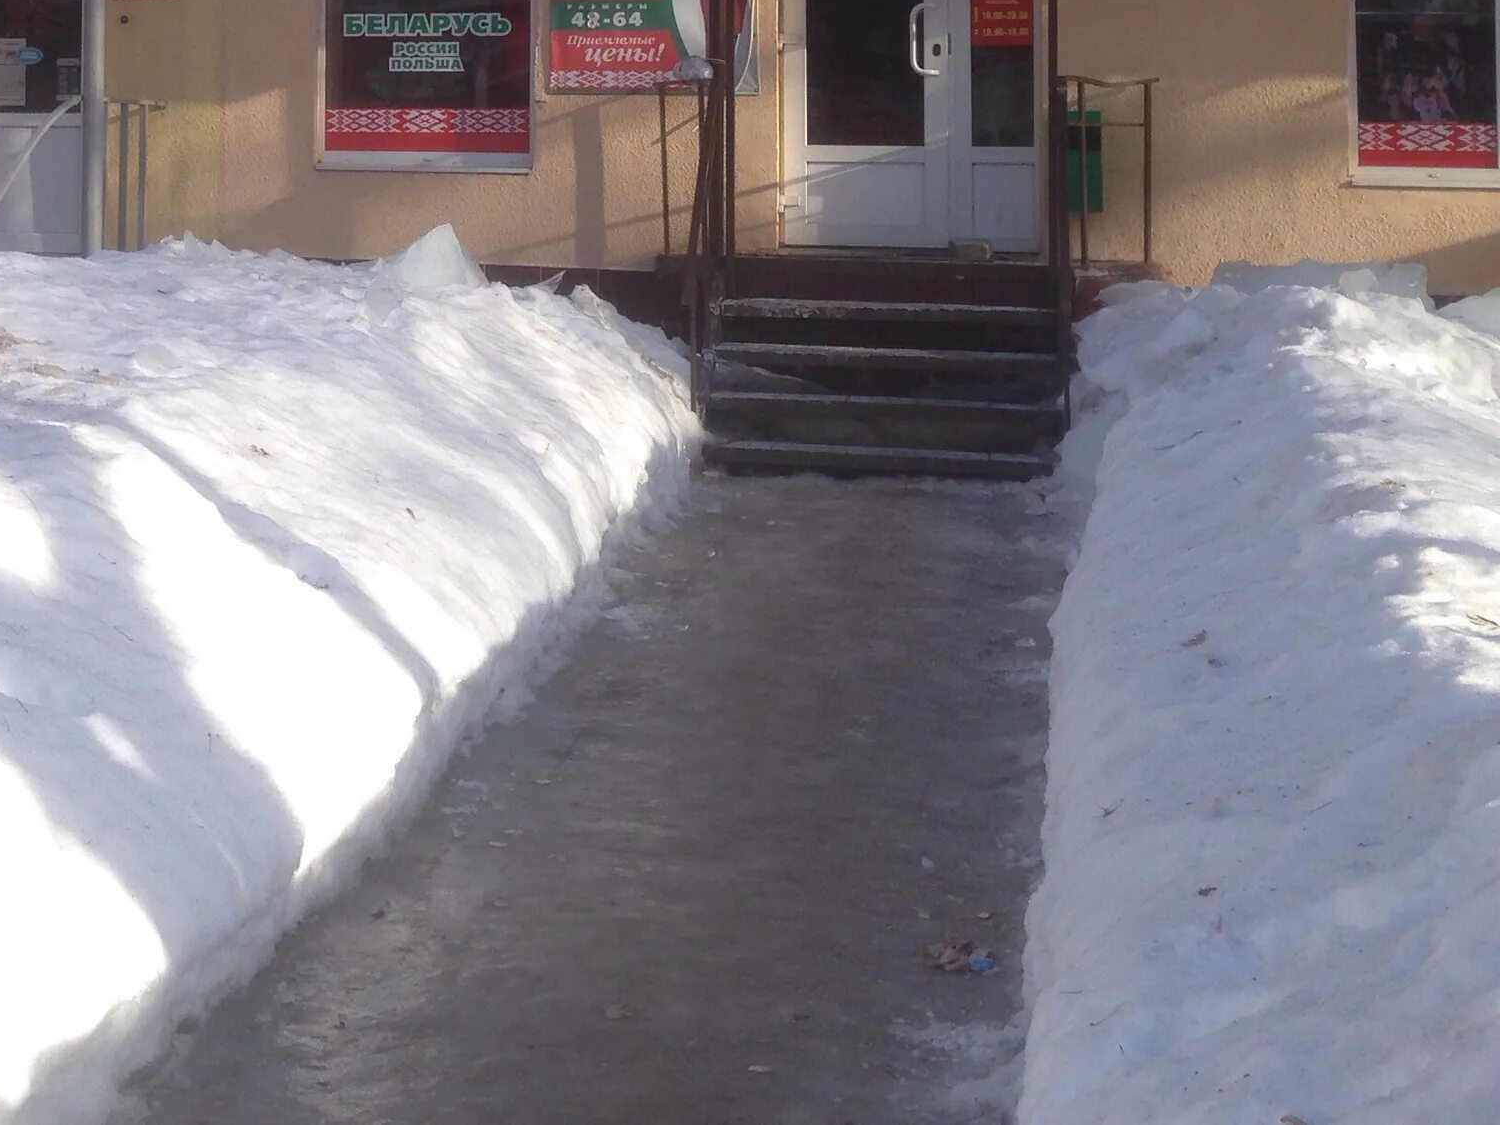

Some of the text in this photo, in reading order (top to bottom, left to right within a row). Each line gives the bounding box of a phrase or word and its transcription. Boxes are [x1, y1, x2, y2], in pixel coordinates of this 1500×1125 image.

[344, 13, 511, 37] БЕЛАРУСЬ
[571, 11, 643, 28] 48-64
[566, 34, 655, 47] Приемлемые
[394, 43, 458, 56] РОССИЯ
[585, 43, 665, 67] цены!
[390, 58, 463, 71] ПОЛЬША
